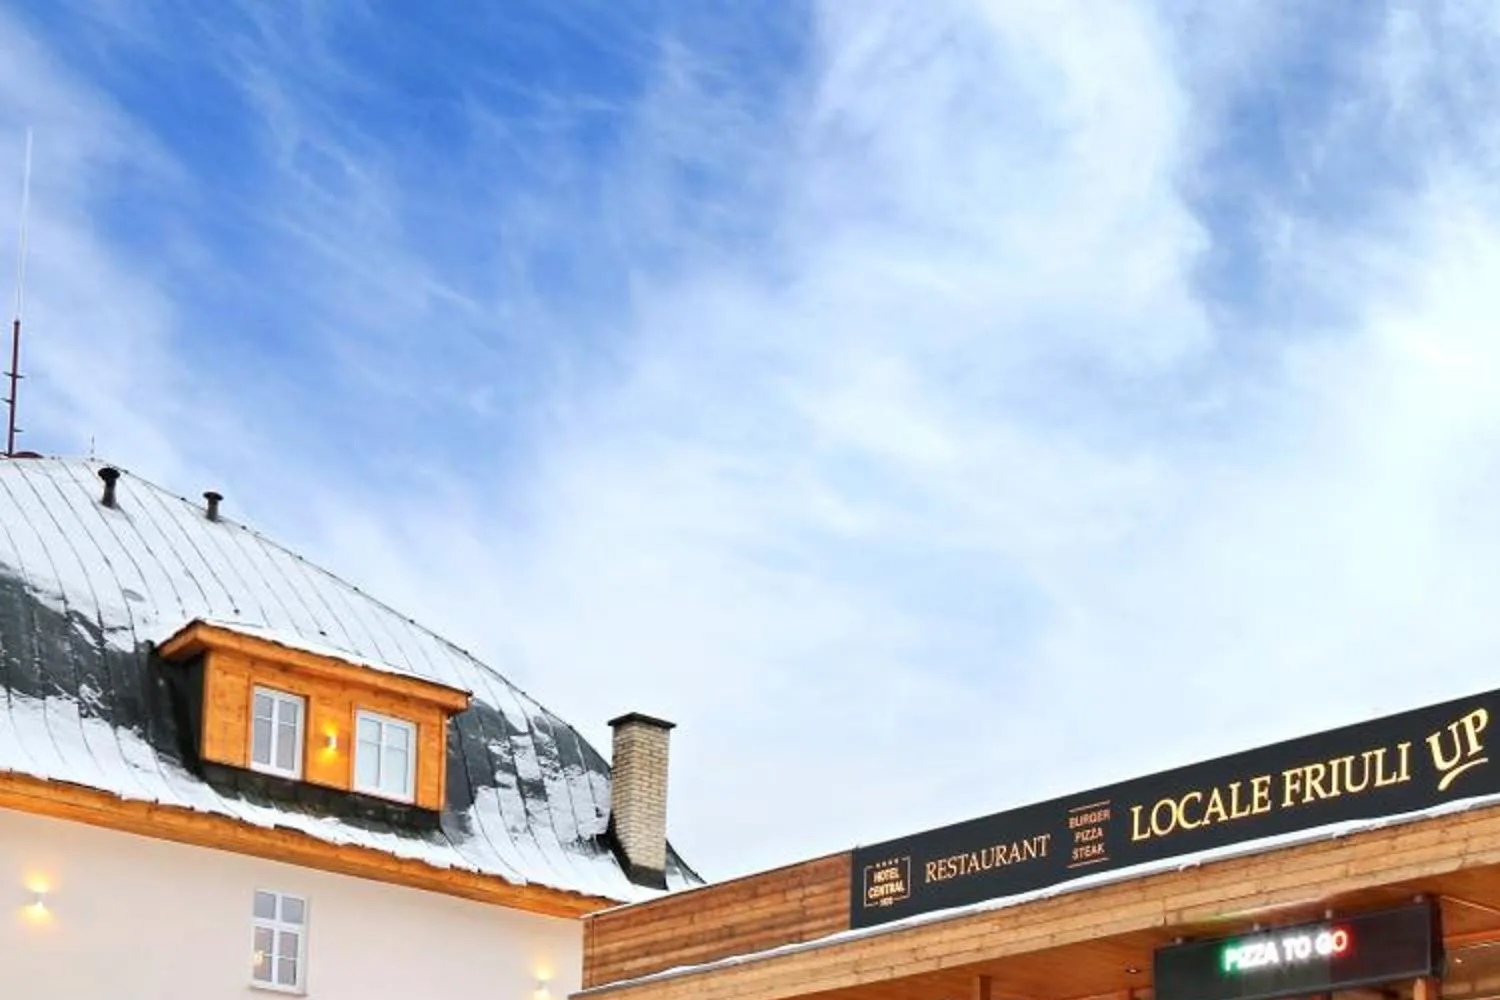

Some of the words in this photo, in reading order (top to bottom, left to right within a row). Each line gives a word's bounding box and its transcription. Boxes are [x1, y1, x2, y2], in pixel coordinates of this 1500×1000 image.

[1130, 775, 1272, 841] LOCALE
[1282, 741, 1412, 808] FRIULI
[1425, 708, 1489, 772] UP
[1068, 809, 1110, 829] BURGER
[1074, 828, 1103, 843] PIZZA
[924, 834, 1051, 884] RESTAURANT
[1072, 843, 1105, 860] STEAK
[873, 868, 899, 884] HOTEL
[868, 880, 905, 899] CENTRAL
[1223, 943, 1279, 972] PIZZA
[1283, 937, 1311, 962] TO
[1315, 929, 1348, 955] GO
